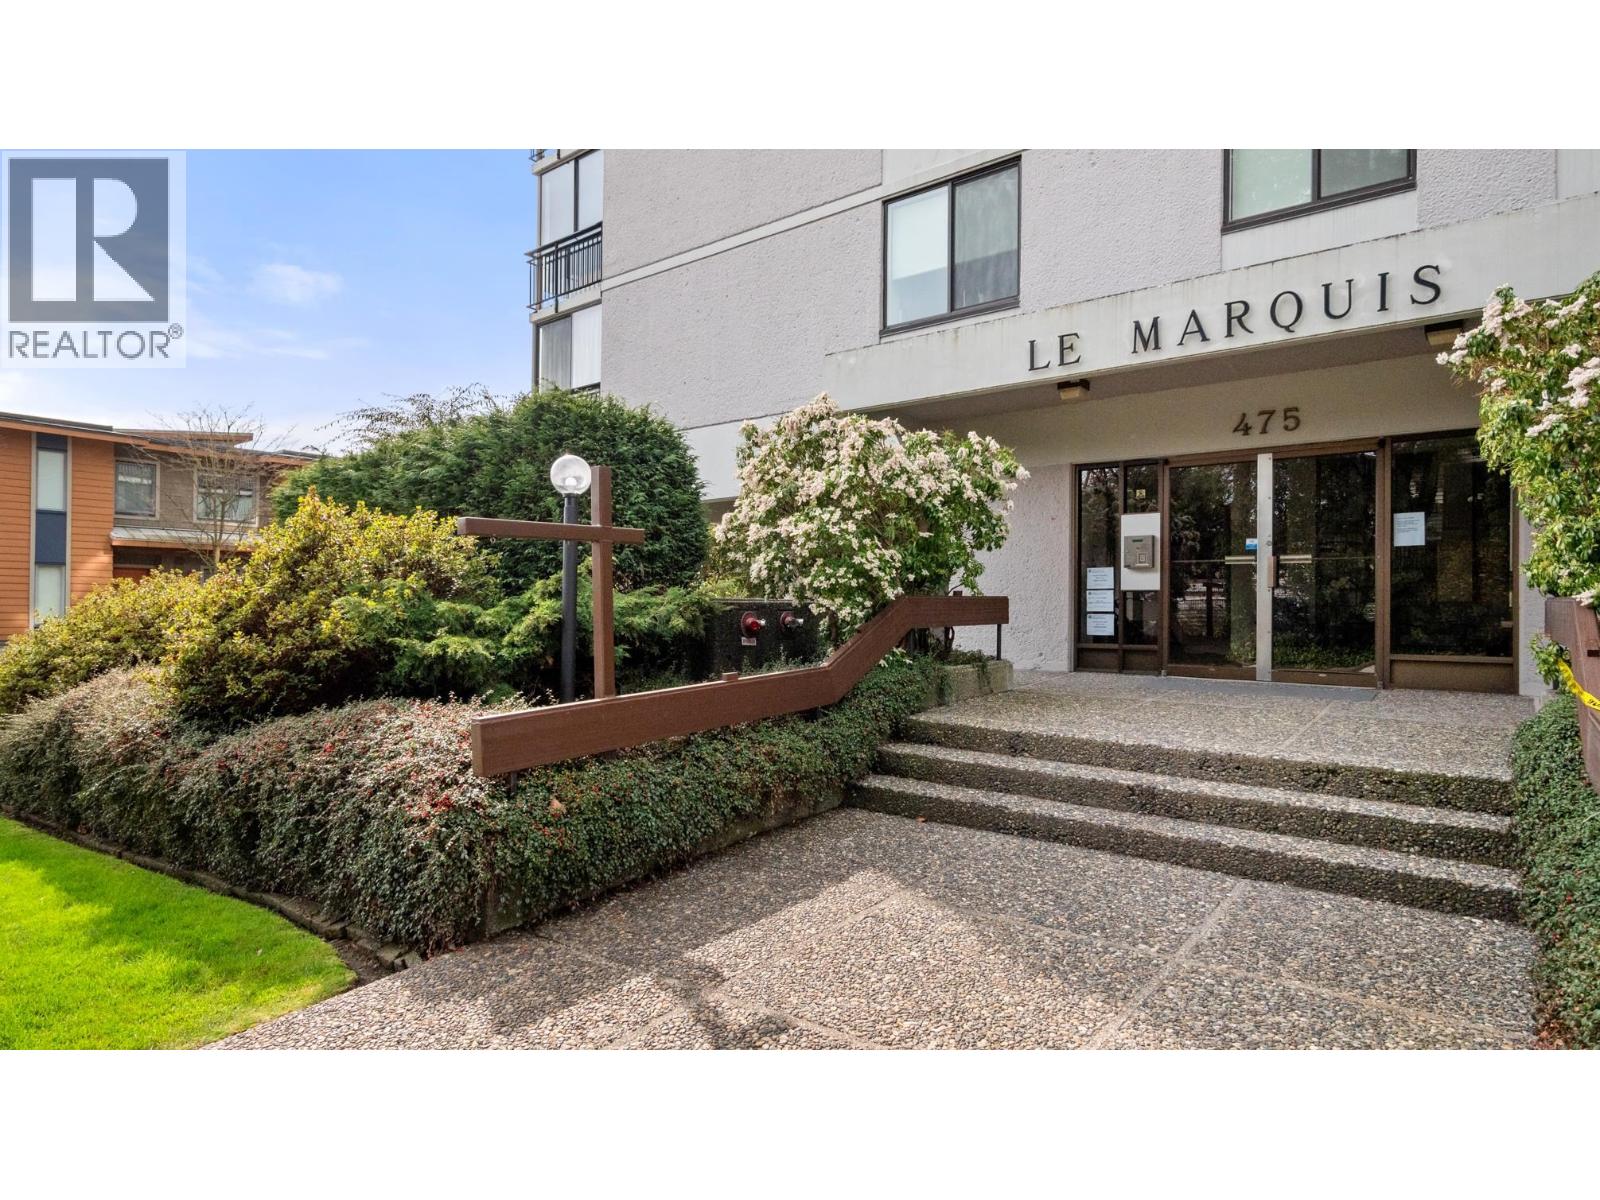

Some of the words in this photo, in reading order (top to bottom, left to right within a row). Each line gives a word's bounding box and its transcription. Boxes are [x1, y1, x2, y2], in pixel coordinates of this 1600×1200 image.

[1028, 332, 1082, 372] LE
[1131, 263, 1442, 354] MARQUIS
[1232, 406, 1301, 437] 475
